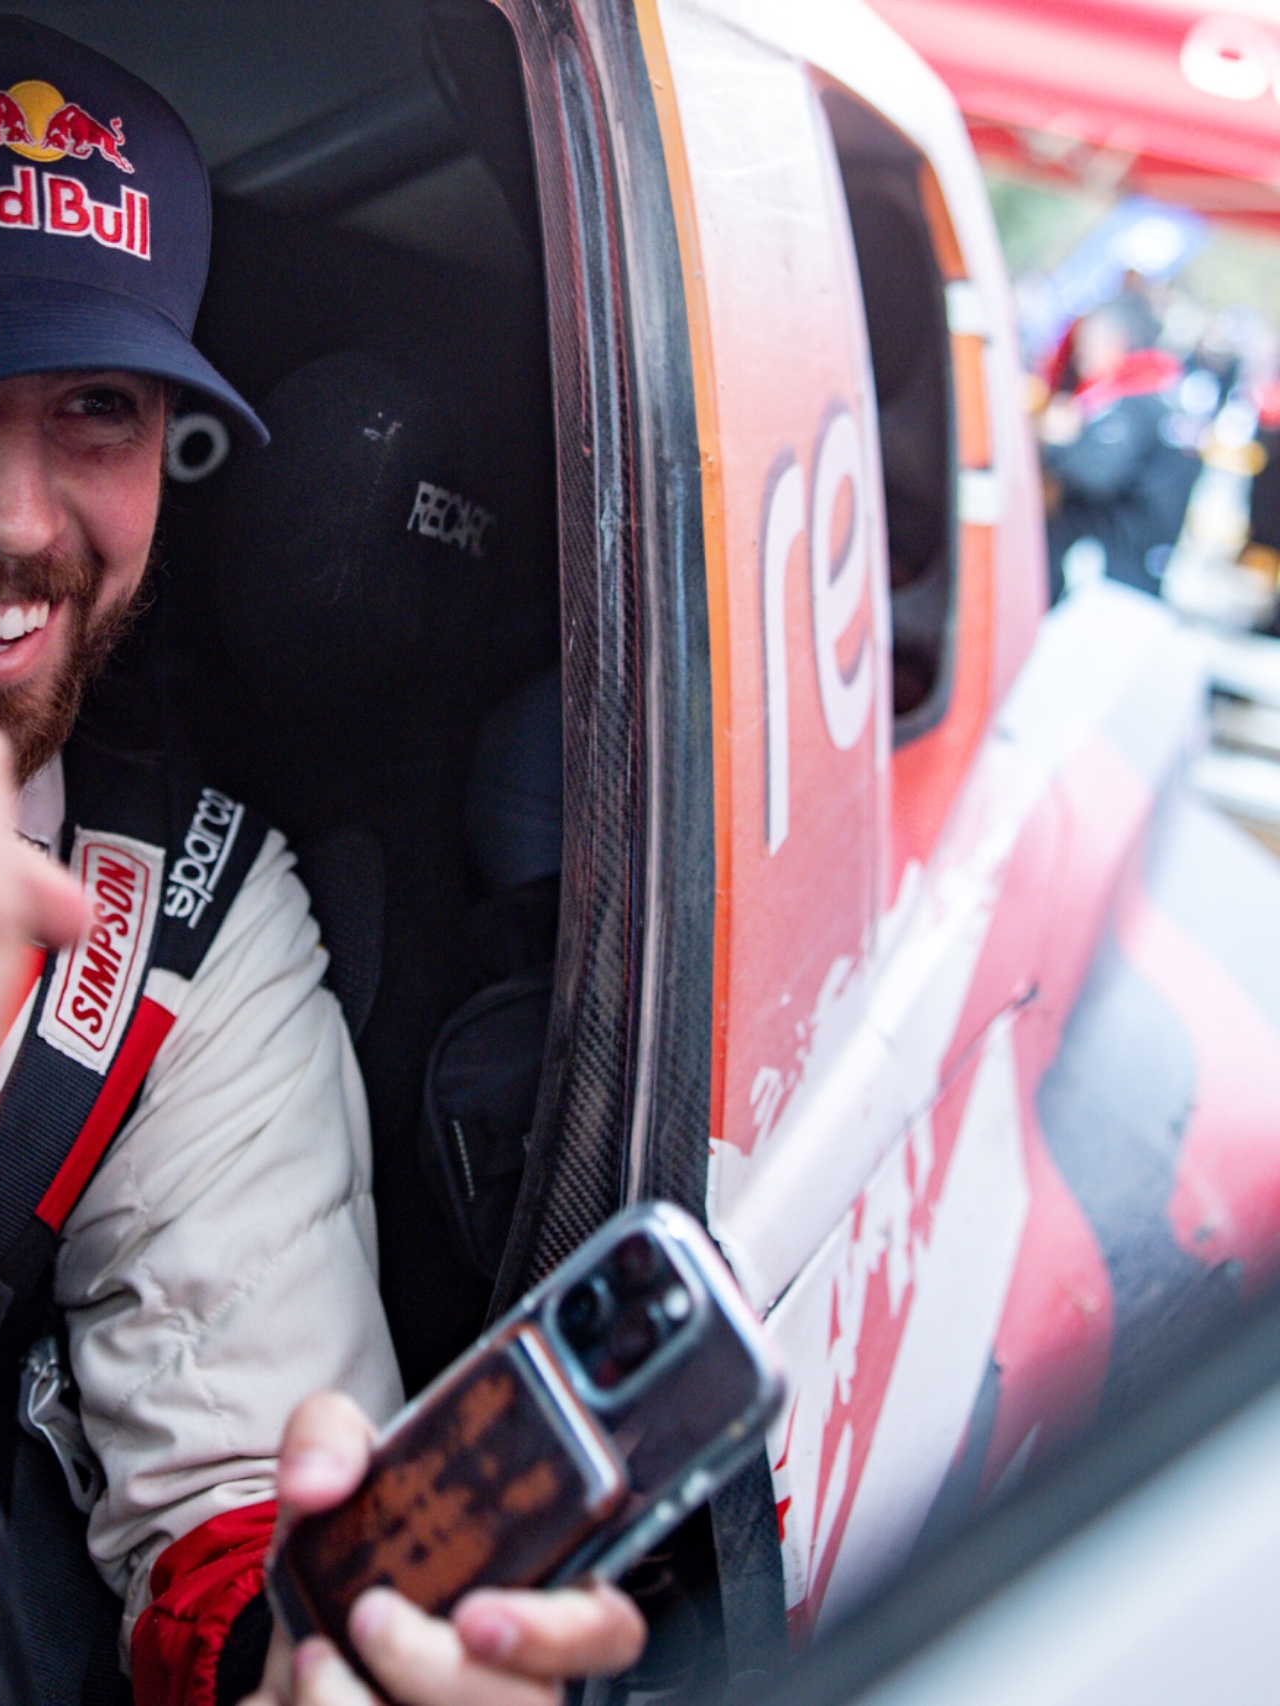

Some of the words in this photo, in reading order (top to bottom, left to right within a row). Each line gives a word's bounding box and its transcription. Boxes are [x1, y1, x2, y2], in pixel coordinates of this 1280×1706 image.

[42, 171, 151, 261] Bull
[163, 786, 242, 924] sparco
[71, 855, 137, 1035] SIMPSON
